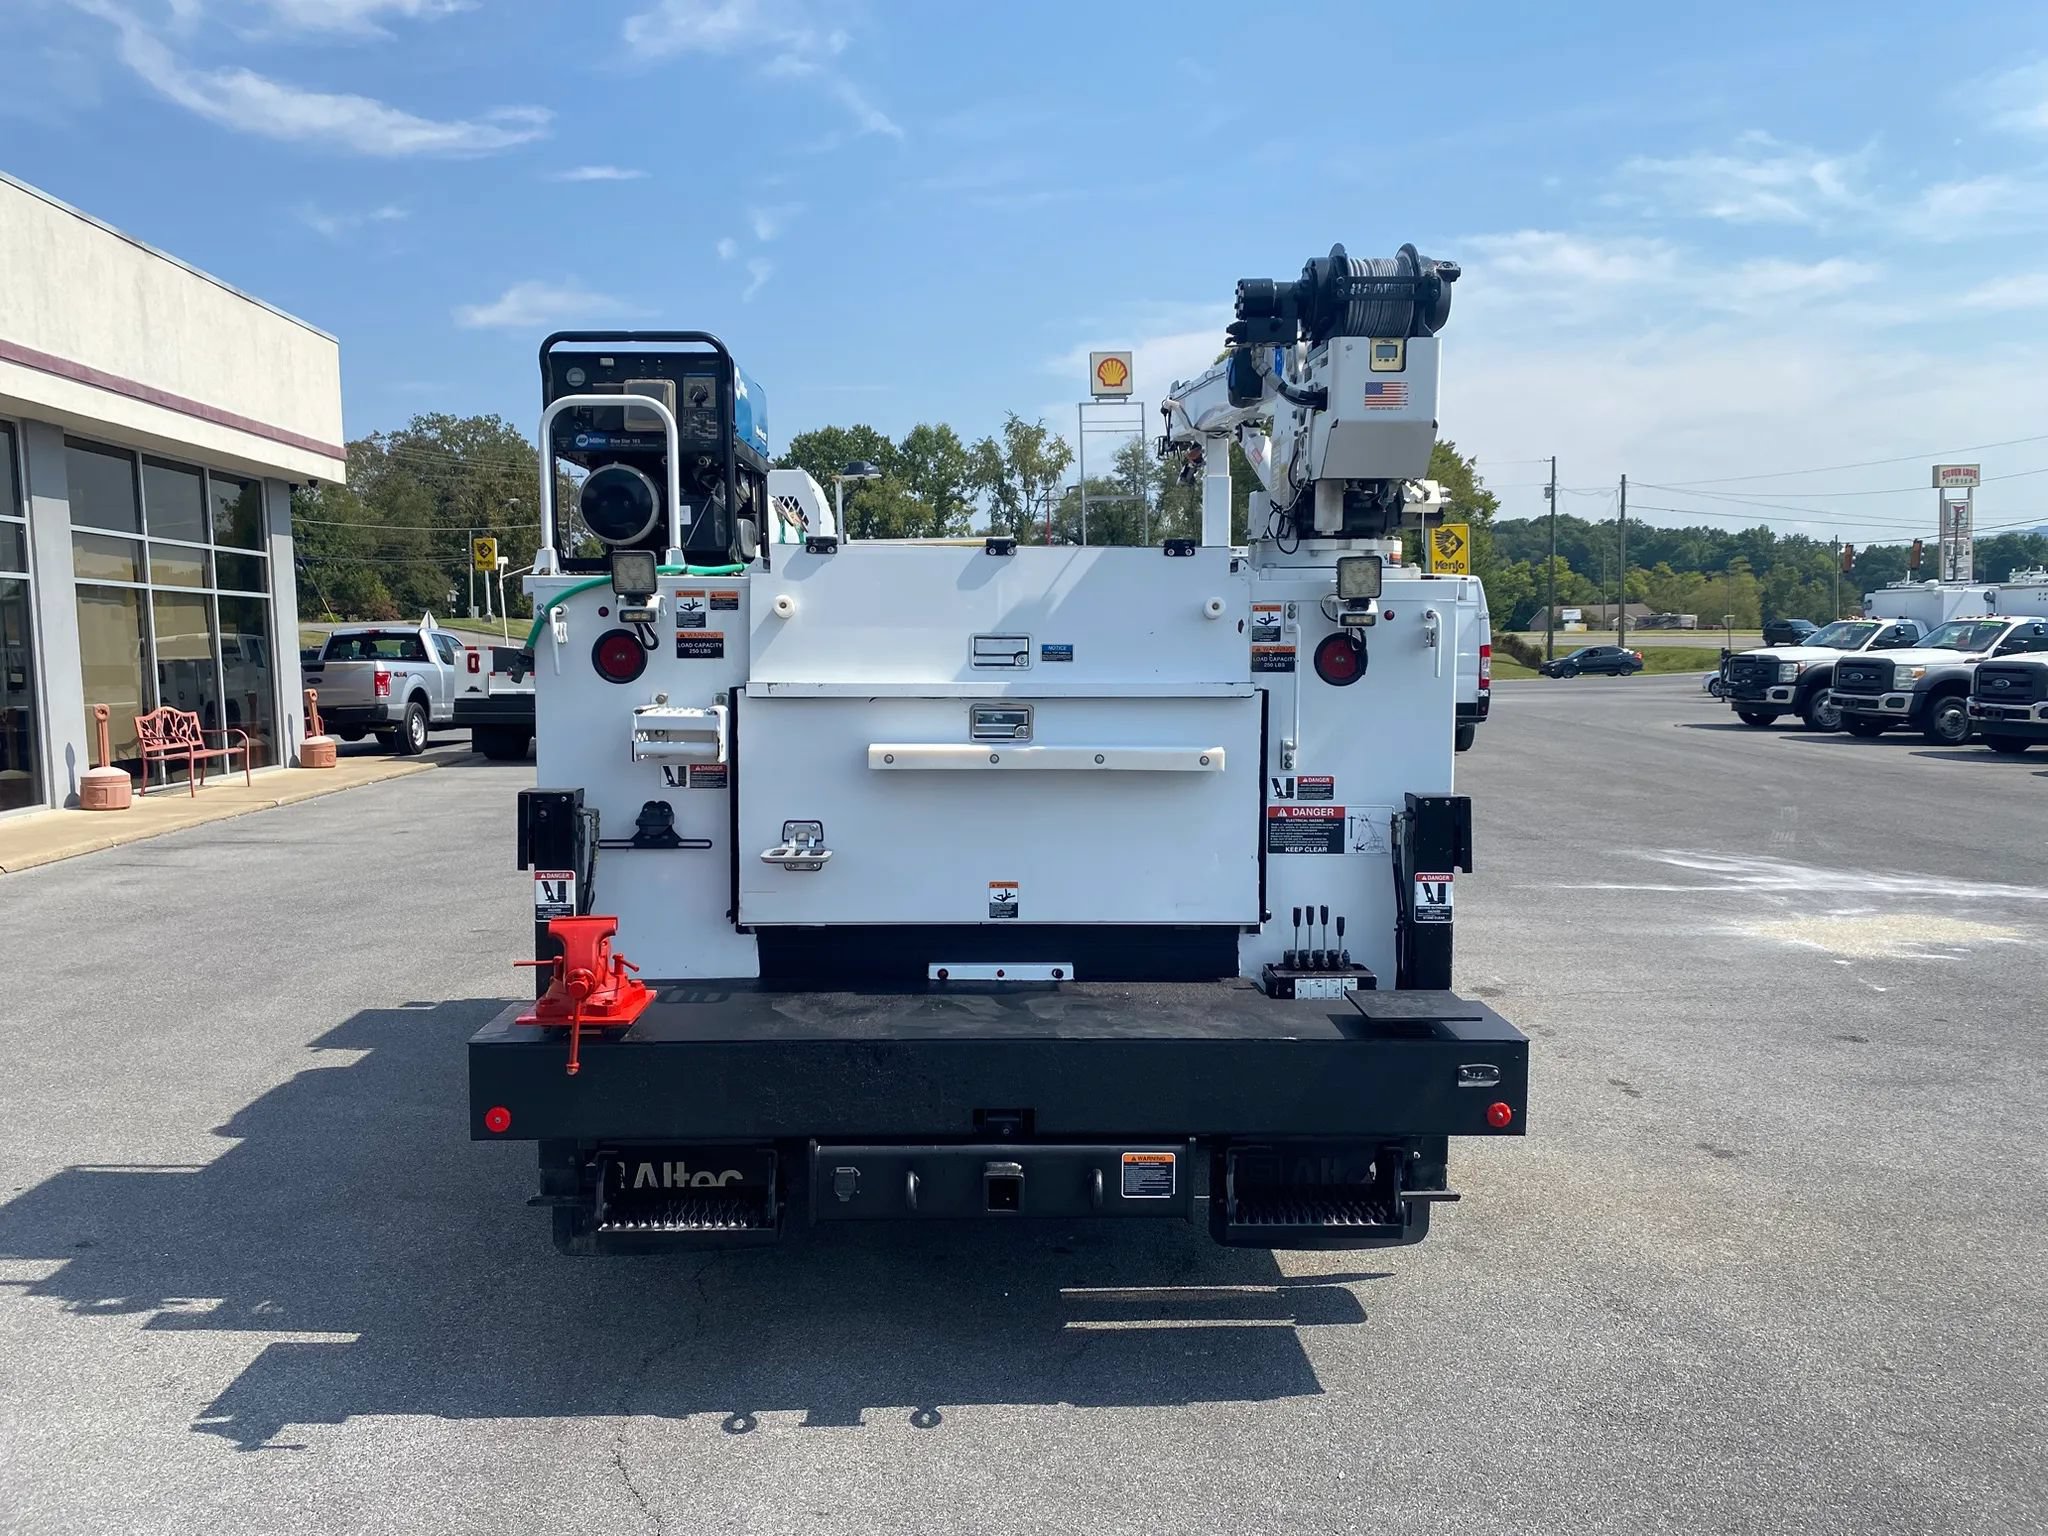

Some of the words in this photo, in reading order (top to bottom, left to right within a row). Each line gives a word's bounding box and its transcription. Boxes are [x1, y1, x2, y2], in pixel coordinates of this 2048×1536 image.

[1435, 560, 1465, 573] Kenjo
[1292, 808, 1335, 816] DANGER
[633, 1161, 744, 1189] Altec
